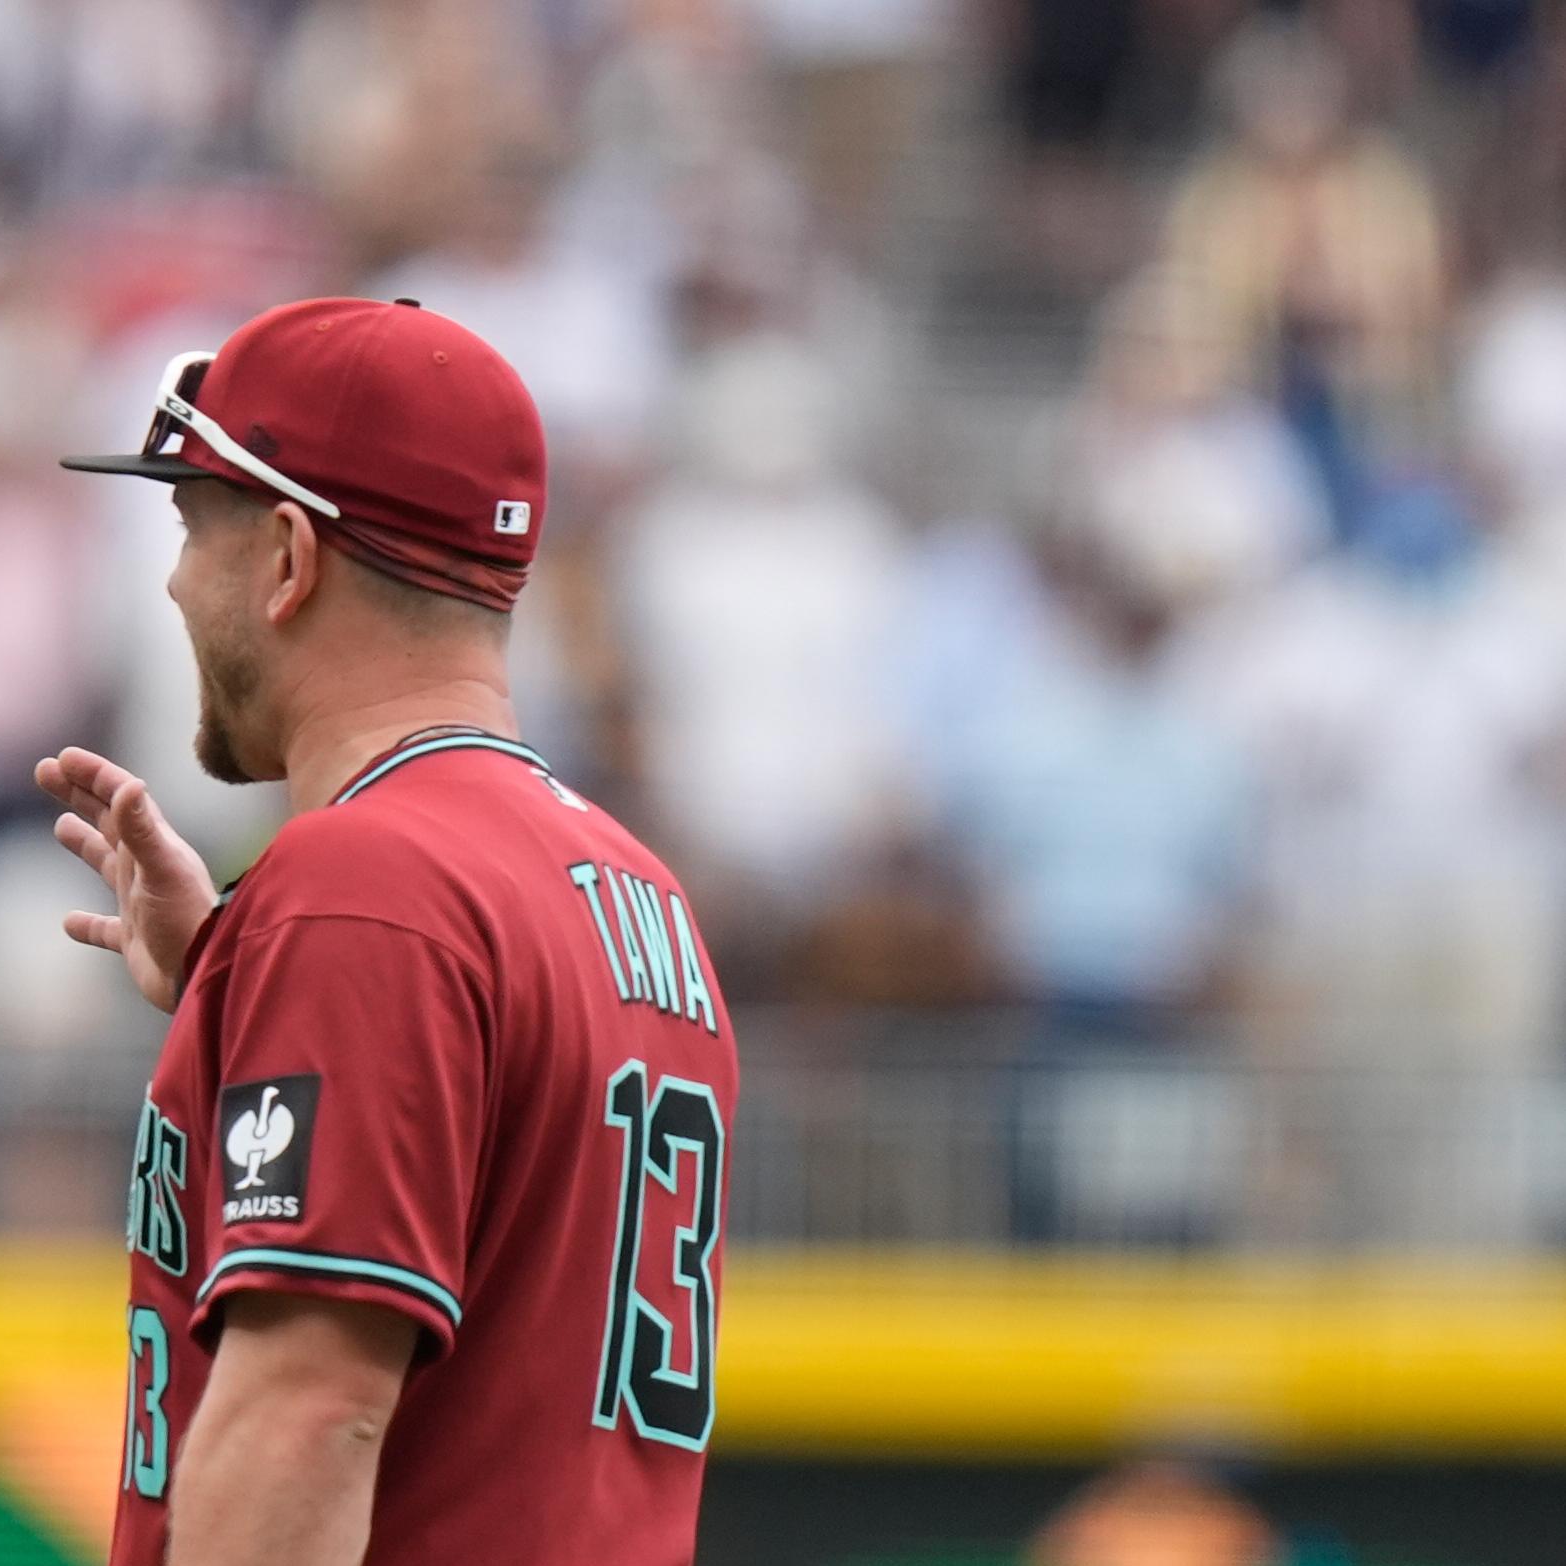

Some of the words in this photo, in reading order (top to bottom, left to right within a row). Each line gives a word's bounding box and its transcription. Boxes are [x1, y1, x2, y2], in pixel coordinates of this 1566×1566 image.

[569, 861, 718, 1036] TAWA
[223, 1195, 299, 1223] RAUSS
[592, 1058, 725, 1452] 13
